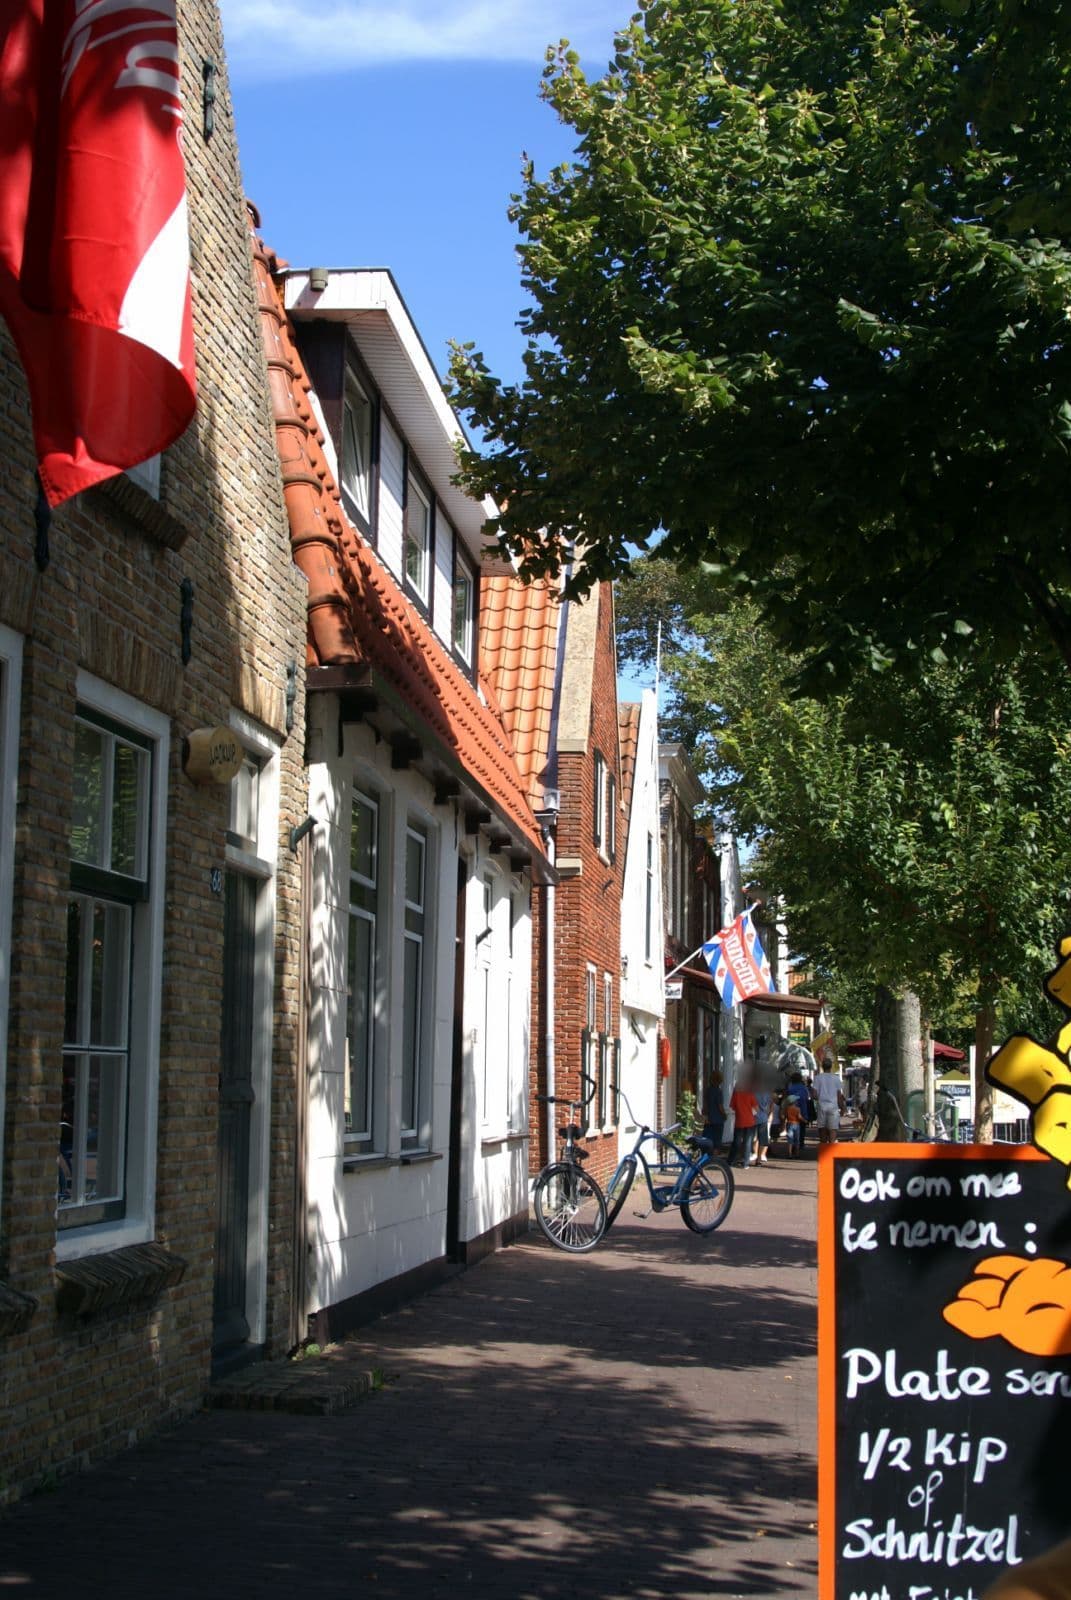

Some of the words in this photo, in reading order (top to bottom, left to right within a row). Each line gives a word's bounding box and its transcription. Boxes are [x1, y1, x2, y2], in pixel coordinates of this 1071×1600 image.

[840, 1167, 901, 1203] Ook
[907, 1175, 952, 1198] om
[960, 1171, 1023, 1199] mee
[842, 1212, 879, 1253] te
[889, 1219, 1007, 1250] nemen
[842, 1348, 992, 1402] Plate
[858, 1427, 912, 1481] 1/2
[908, 1469, 945, 1528] of
[842, 1513, 1024, 1567] Schnitzel
